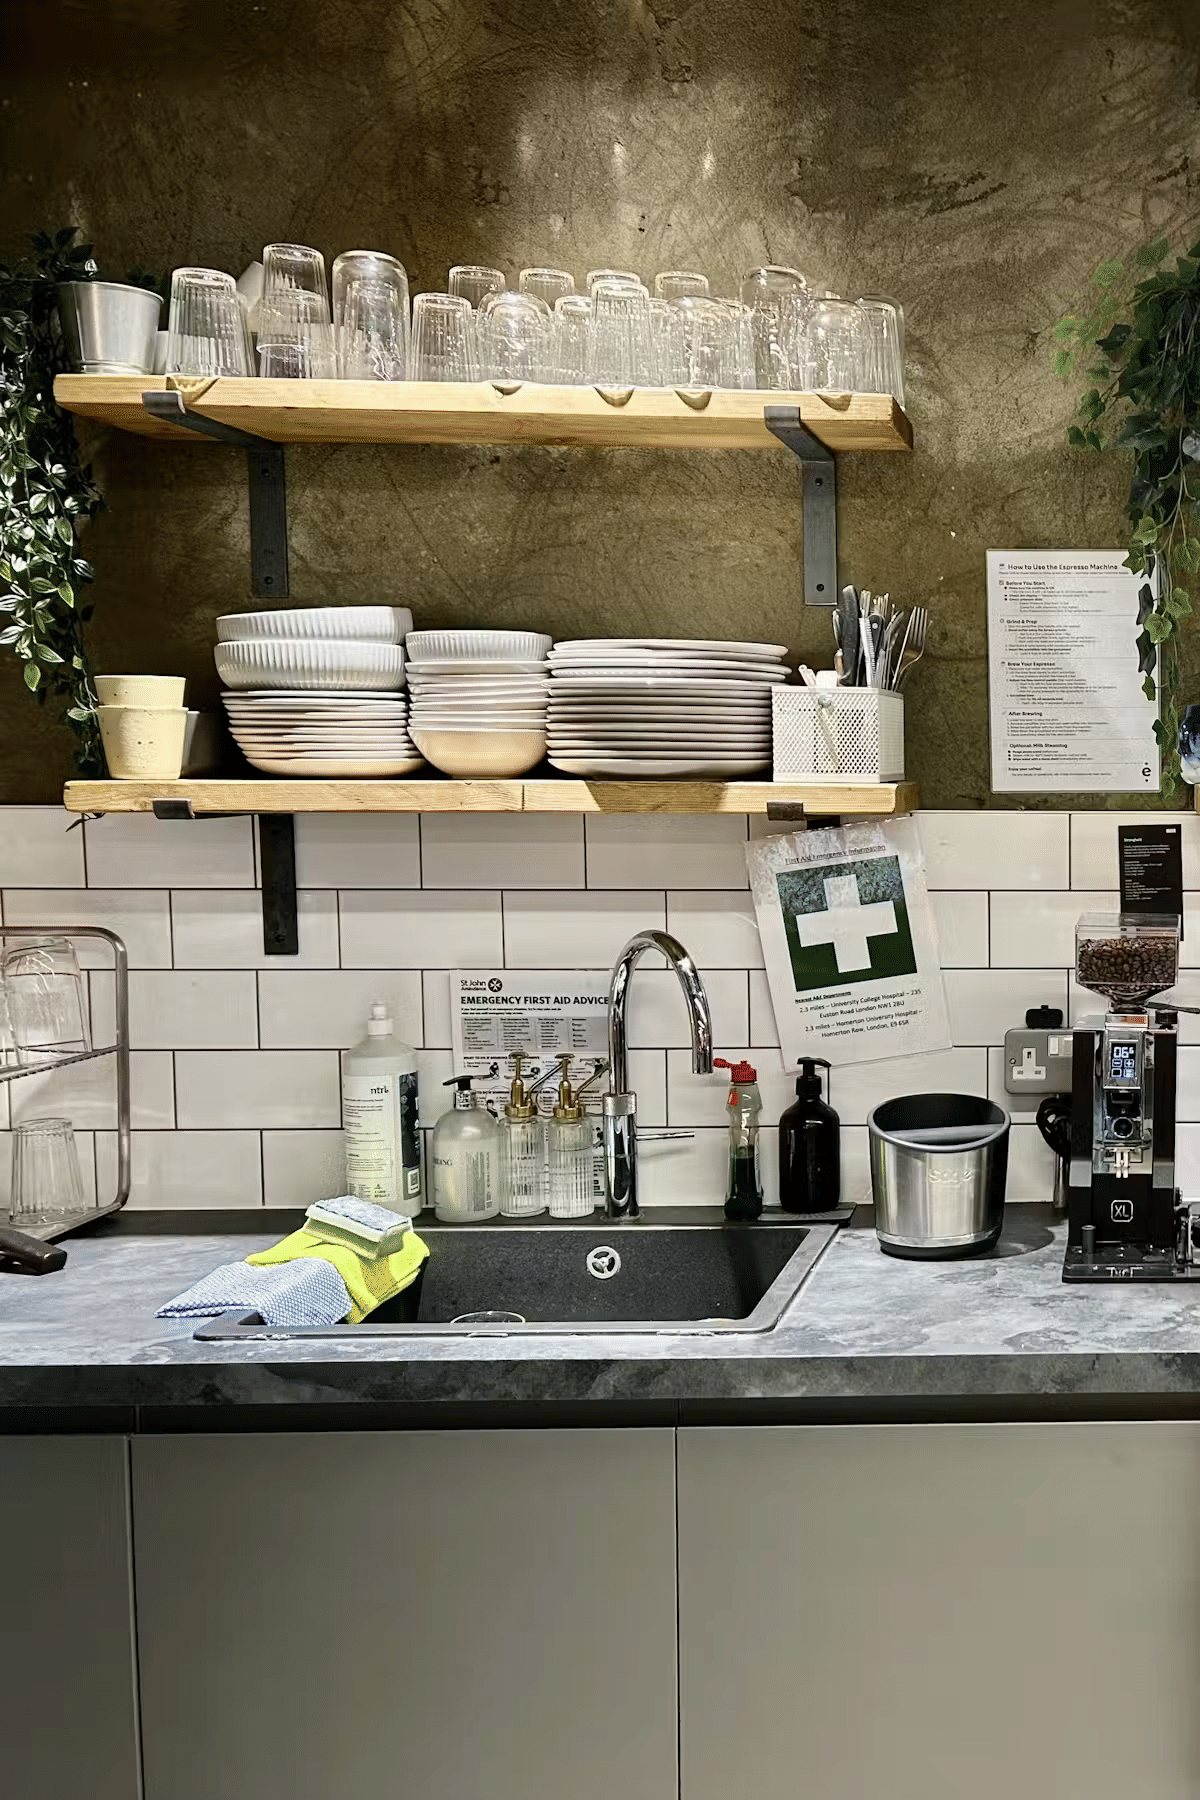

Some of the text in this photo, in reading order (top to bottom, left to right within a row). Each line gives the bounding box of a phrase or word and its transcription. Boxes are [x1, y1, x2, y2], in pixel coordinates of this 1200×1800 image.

[460, 996, 608, 1004] EMERGENCY FIRST AID ADVICE
[830, 999, 859, 1008] University
[860, 996, 881, 1004] College
[881, 992, 905, 1000] Hospital
[855, 1005, 877, 1013] London
[836, 1018, 864, 1027] Homerton
[865, 1014, 894, 1022] University
[895, 1009, 918, 1018] Hospital
[821, 1030, 850, 1038] Homerton
[1114, 1205, 1129, 1217] XL
